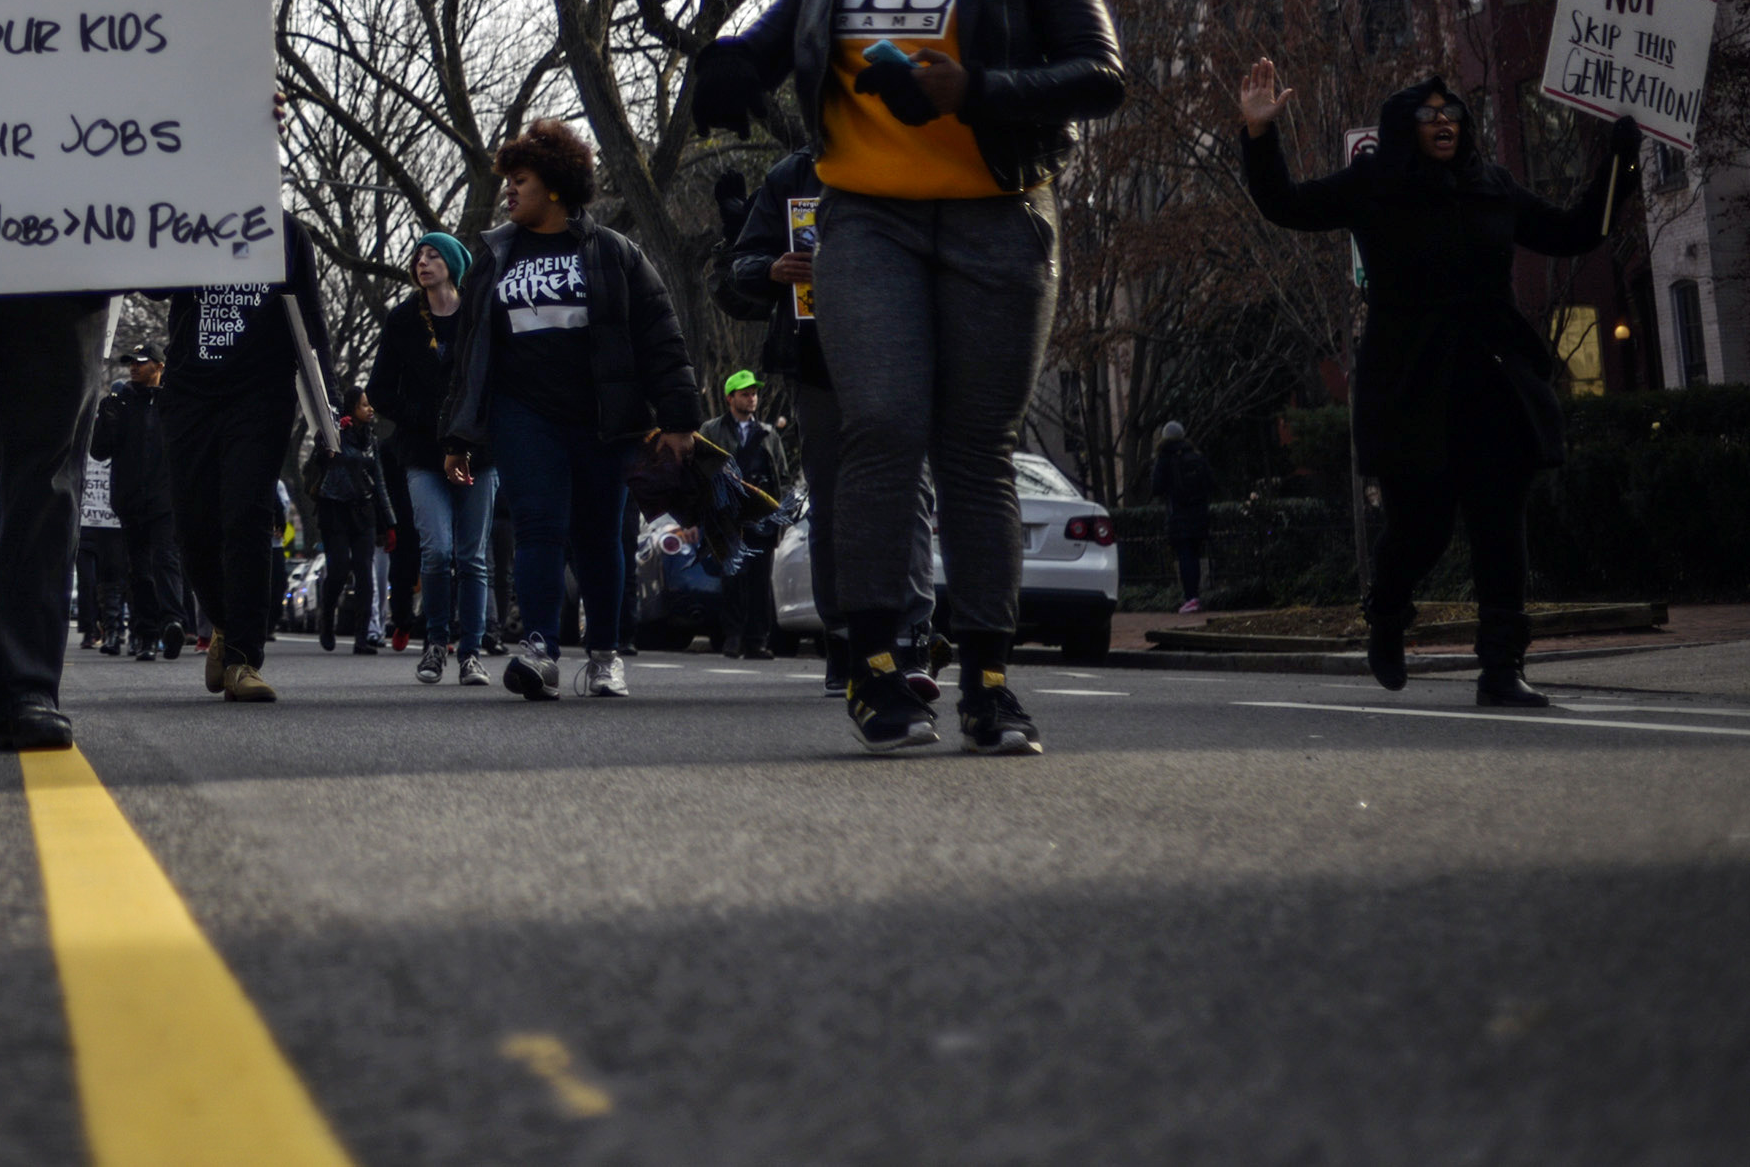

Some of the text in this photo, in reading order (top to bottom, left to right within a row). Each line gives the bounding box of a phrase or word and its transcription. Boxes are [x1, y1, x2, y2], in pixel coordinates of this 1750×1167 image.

[80, 10, 168, 54] KIDS
[840, 16, 935, 27] RAMS
[1570, 10, 1676, 64] SKIP THIS
[1562, 47, 1701, 140] GENERATION!
[60, 114, 182, 156] JOBS
[148, 201, 274, 249] PEACE
[200, 291, 261, 306] Jordan&
[200, 305, 240, 319] Eric&
[198, 332, 234, 346] Ezell
[199, 318, 245, 332] Mike&
